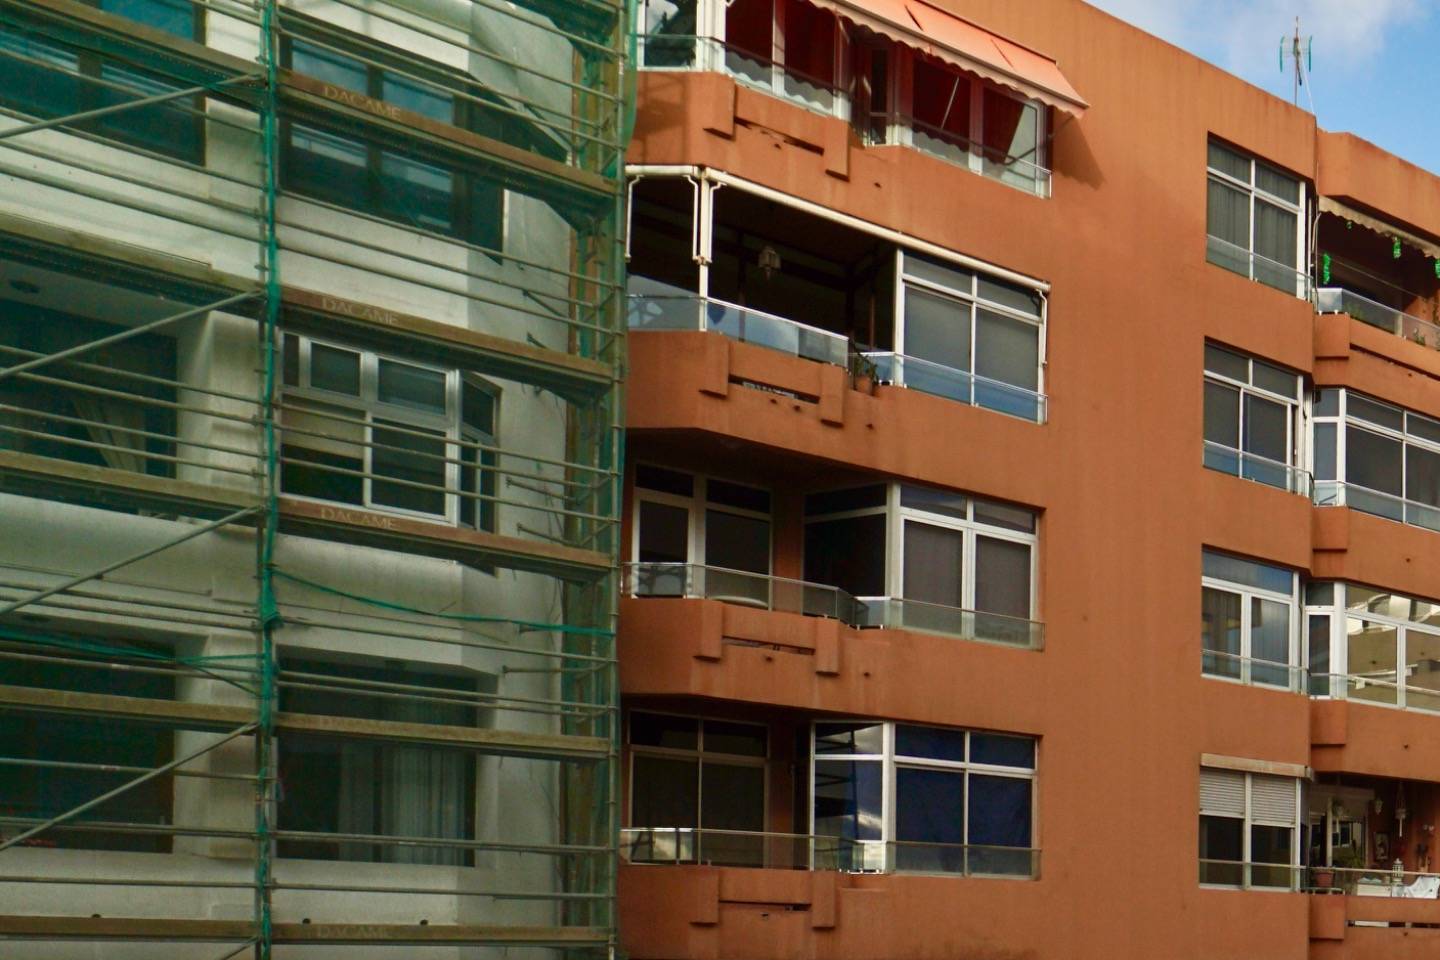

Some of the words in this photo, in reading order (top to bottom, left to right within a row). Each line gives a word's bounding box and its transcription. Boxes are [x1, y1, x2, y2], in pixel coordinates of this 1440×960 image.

[323, 85, 402, 119] DACAME
[321, 297, 399, 326] DACAME
[320, 507, 398, 529] DACAME
